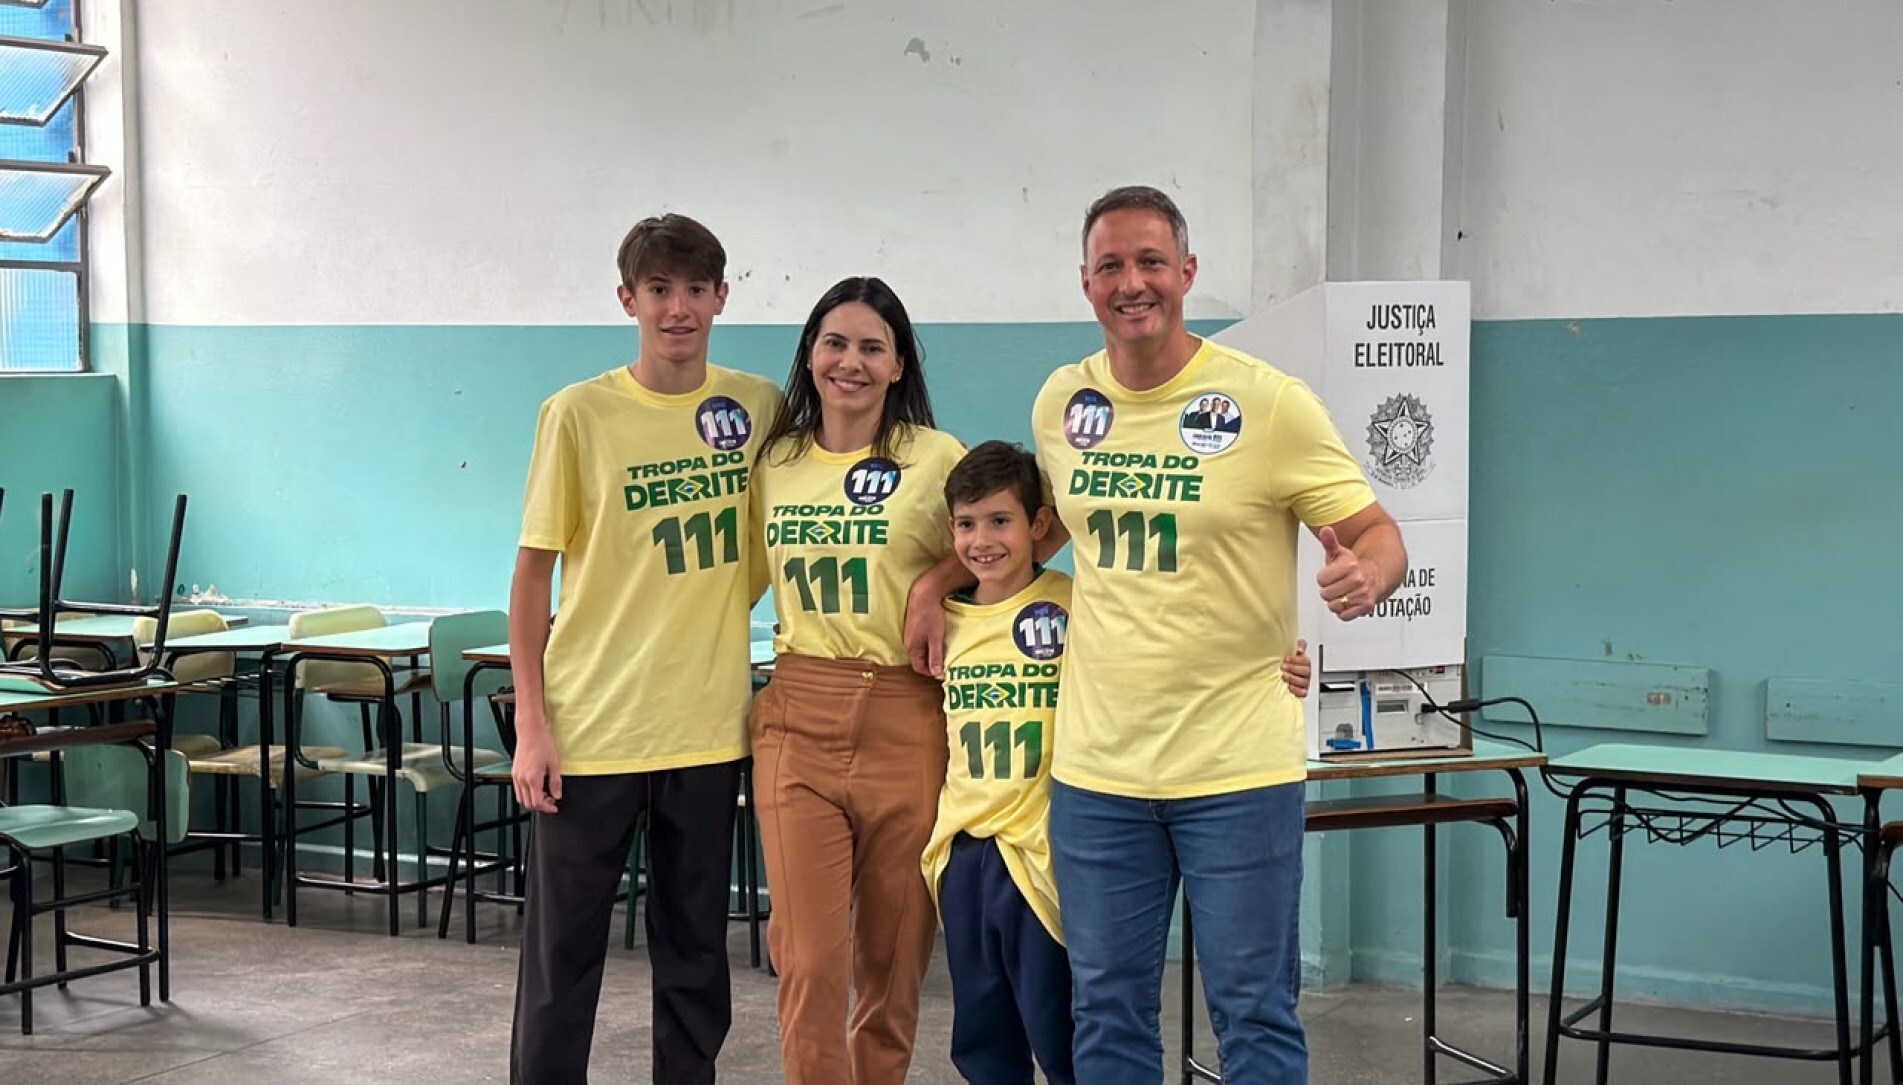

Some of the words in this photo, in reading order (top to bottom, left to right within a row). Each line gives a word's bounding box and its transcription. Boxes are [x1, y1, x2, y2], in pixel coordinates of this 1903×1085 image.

[1366, 304, 1436, 336] JUSTIÇA
[1355, 342, 1444, 367] ELEITORAL
[701, 409, 747, 438] 111
[1070, 403, 1110, 436] 111
[627, 456, 708, 480] TROPA
[711, 451, 745, 467] DO
[1081, 451, 1157, 469] TROPA
[1162, 455, 1199, 470] DO
[623, 467, 749, 511] DERRITE
[851, 469, 897, 494] 111
[1068, 470, 1203, 502] DERRITE
[772, 505, 845, 518] TROPA
[849, 504, 884, 516] DO
[652, 507, 740, 575] 111
[767, 519, 889, 547] DERRITE
[1087, 509, 1178, 573] 111
[784, 557, 869, 614] 111
[1419, 568, 1436, 587] DE
[1019, 615, 1066, 647] 111
[948, 664, 1016, 680] TROPA
[1023, 663, 1058, 678] DO
[947, 681, 1059, 710] DERRITE
[959, 721, 1043, 779] 111
